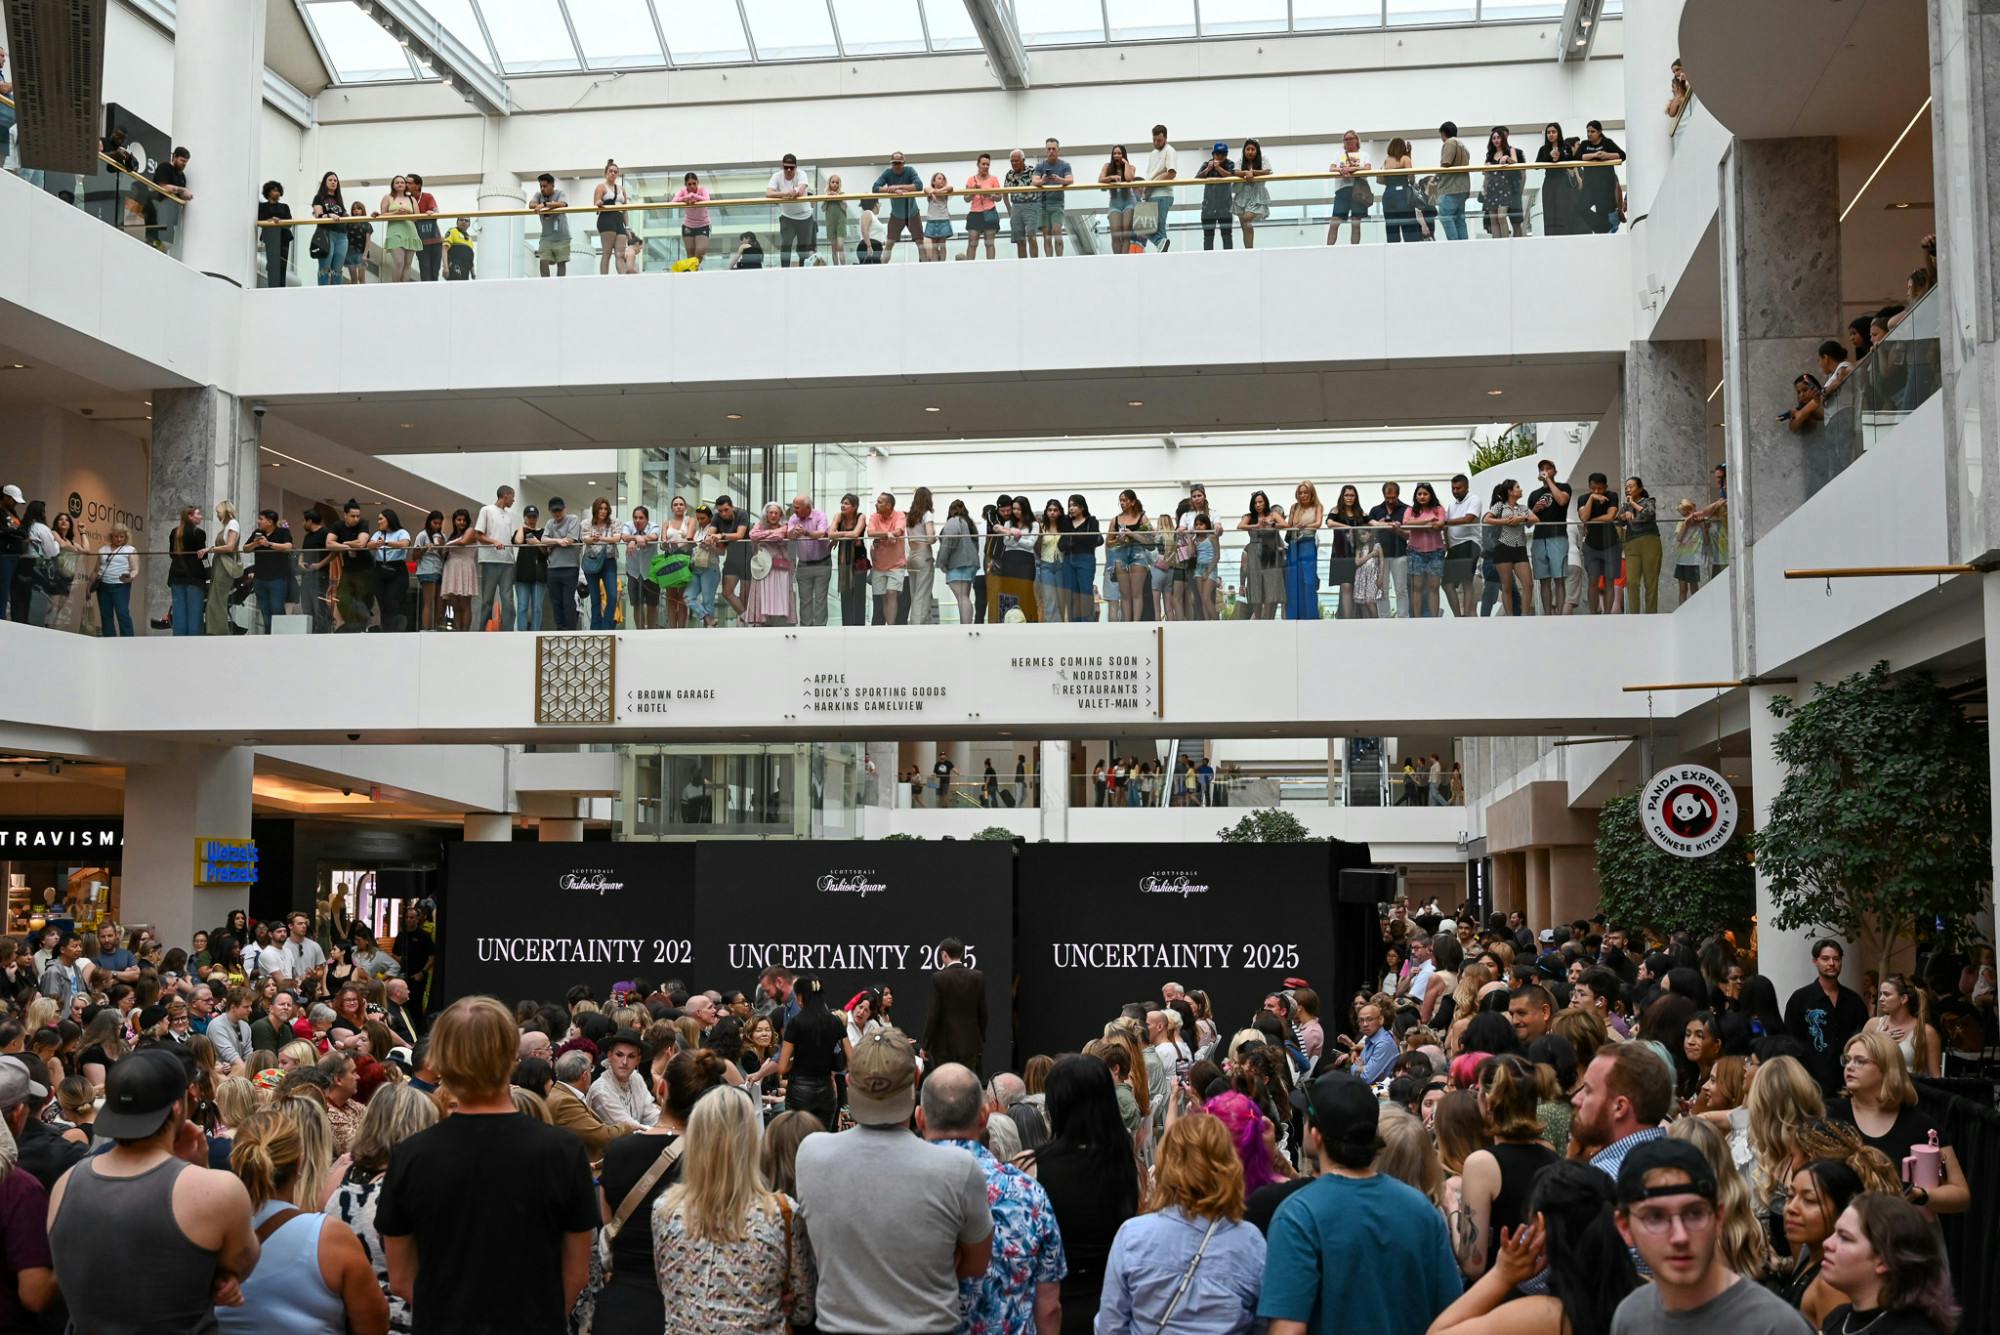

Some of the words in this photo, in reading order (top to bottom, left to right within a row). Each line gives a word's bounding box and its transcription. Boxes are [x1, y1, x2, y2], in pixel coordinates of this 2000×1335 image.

[1011, 657, 1054, 667] HERMES
[1060, 656, 1103, 667] COMING
[1109, 656, 1138, 666] SOON
[814, 674, 846, 684] APPLE
[1072, 670, 1138, 681] NORDSTROM
[637, 689, 672, 699] BROWN
[677, 689, 715, 699] GARAGE
[814, 687, 850, 697] DICK'S
[855, 687, 906, 697] SPORTING
[912, 687, 947, 697] GOODS
[1062, 684, 1138, 695] RESTAURANTS
[637, 703, 668, 713] HOTEL
[814, 701, 859, 711] HARKINS
[864, 700, 924, 711] CAMELVIEW
[1078, 698, 1138, 709] VALET-MAIN
[1648, 774, 1679, 811] PANDA
[1681, 770, 1730, 805] EXPRESS
[0, 831, 124, 846] TRAVISM
[1653, 825, 1692, 852] CHINESE
[1696, 820, 1730, 851] KITCHEN
[207, 863, 259, 882] Pretzels
[477, 938, 645, 963] UNCERTAINTY
[1052, 943, 1233, 968] UNCERTAINTY
[1243, 944, 1300, 969] 2025
[728, 944, 910, 970] UNCERTAINTY
[920, 945, 976, 970] 205
